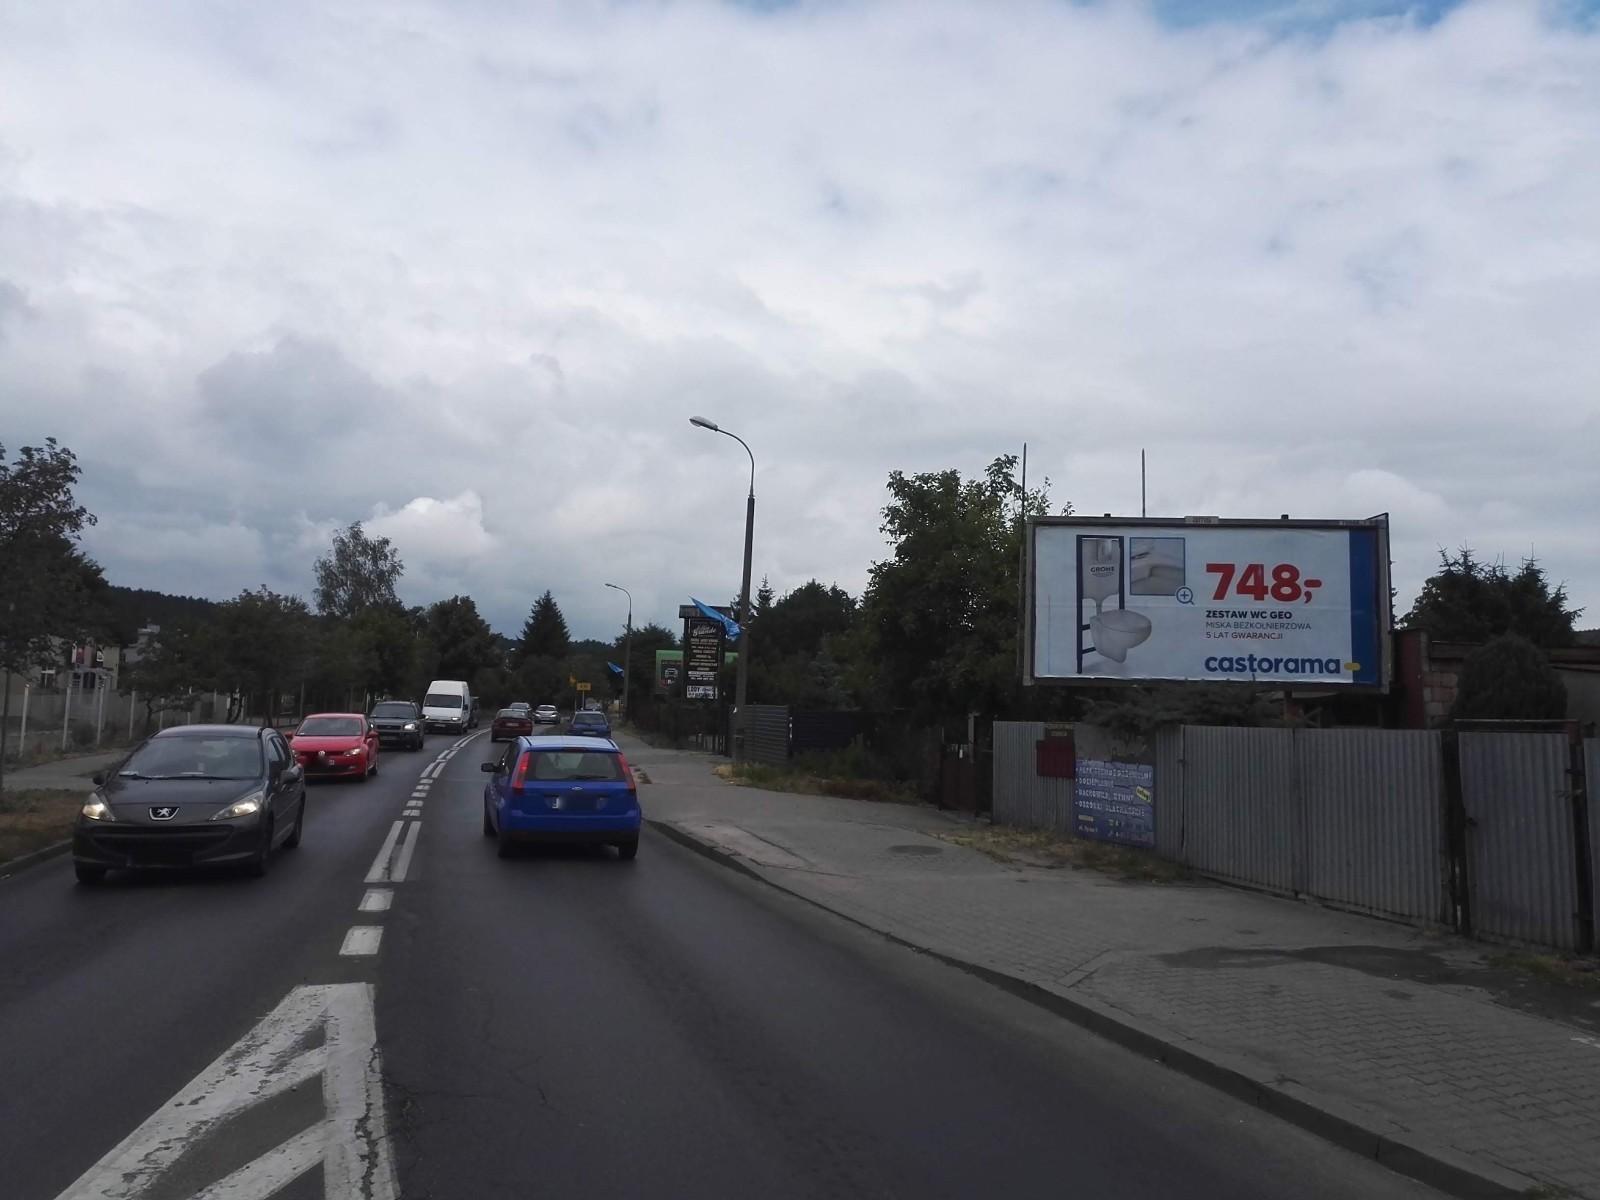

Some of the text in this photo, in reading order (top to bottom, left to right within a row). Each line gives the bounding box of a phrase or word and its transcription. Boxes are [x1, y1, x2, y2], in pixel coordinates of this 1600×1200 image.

[1205, 610, 1292, 619] ZESTAW WC GEO
[1205, 621, 1311, 630] MISKA BEZKOŁNIERZOWA
[1206, 631, 1283, 639] 5 LAT GWARANCJI
[1204, 653, 1341, 674] castorama
